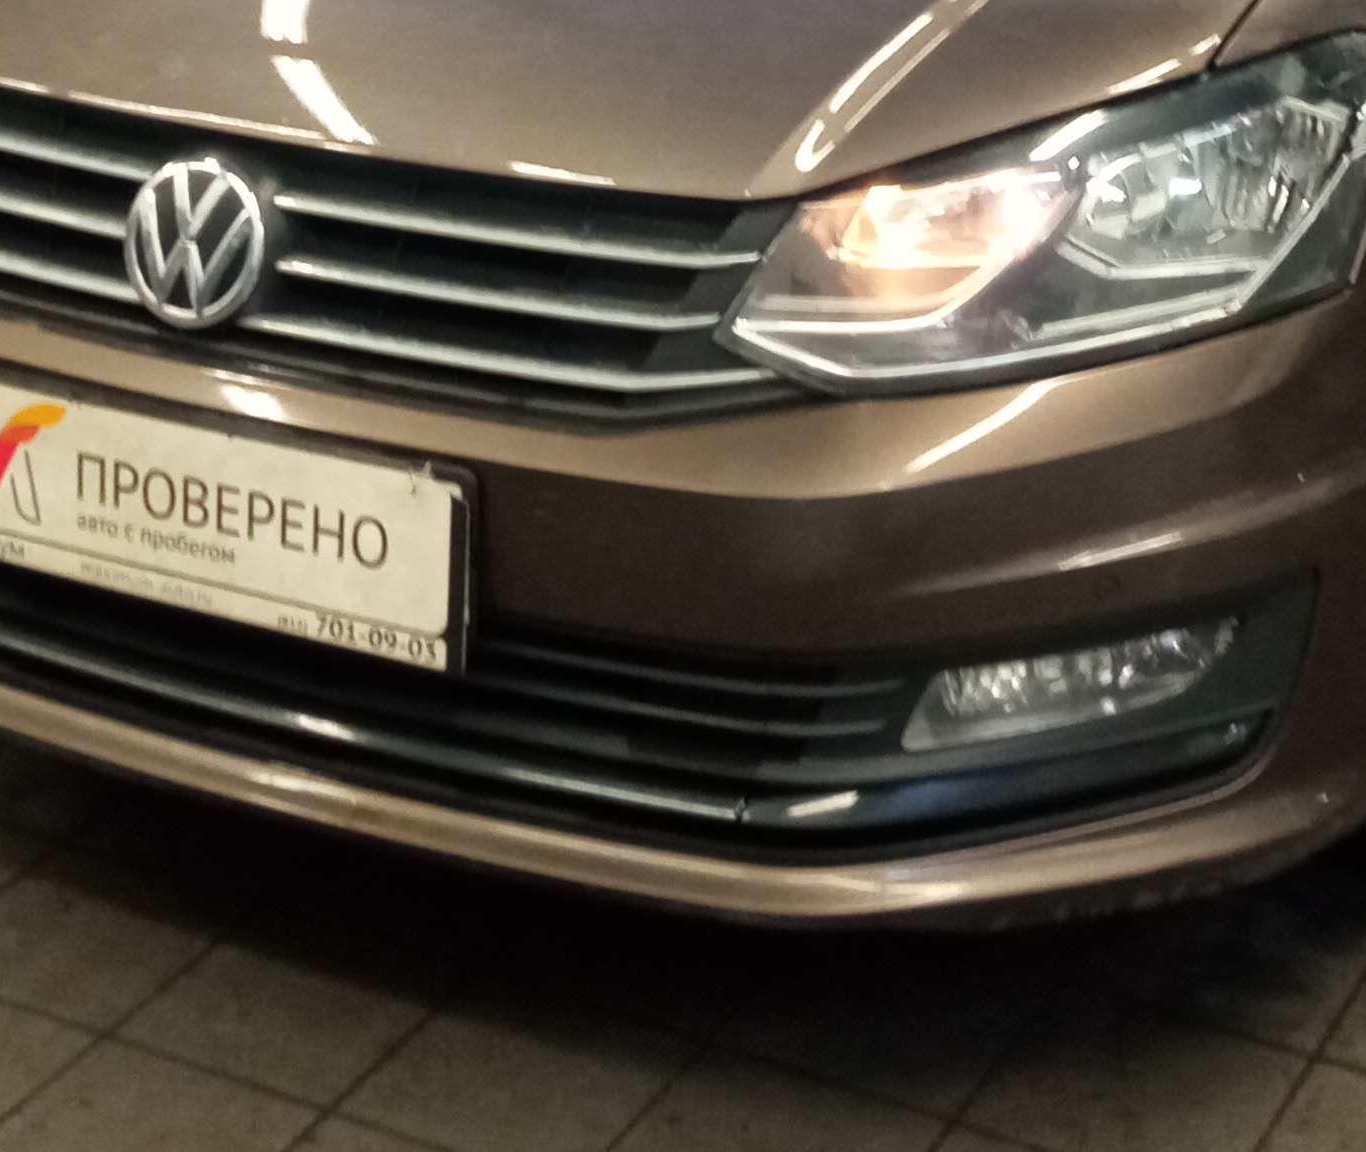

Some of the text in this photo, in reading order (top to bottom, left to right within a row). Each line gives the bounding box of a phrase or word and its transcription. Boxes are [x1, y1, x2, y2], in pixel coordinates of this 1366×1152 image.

[76, 451, 390, 569] ПРОВЕРЕНО
[76, 514, 119, 539] авто
[140, 526, 236, 563] пробегом
